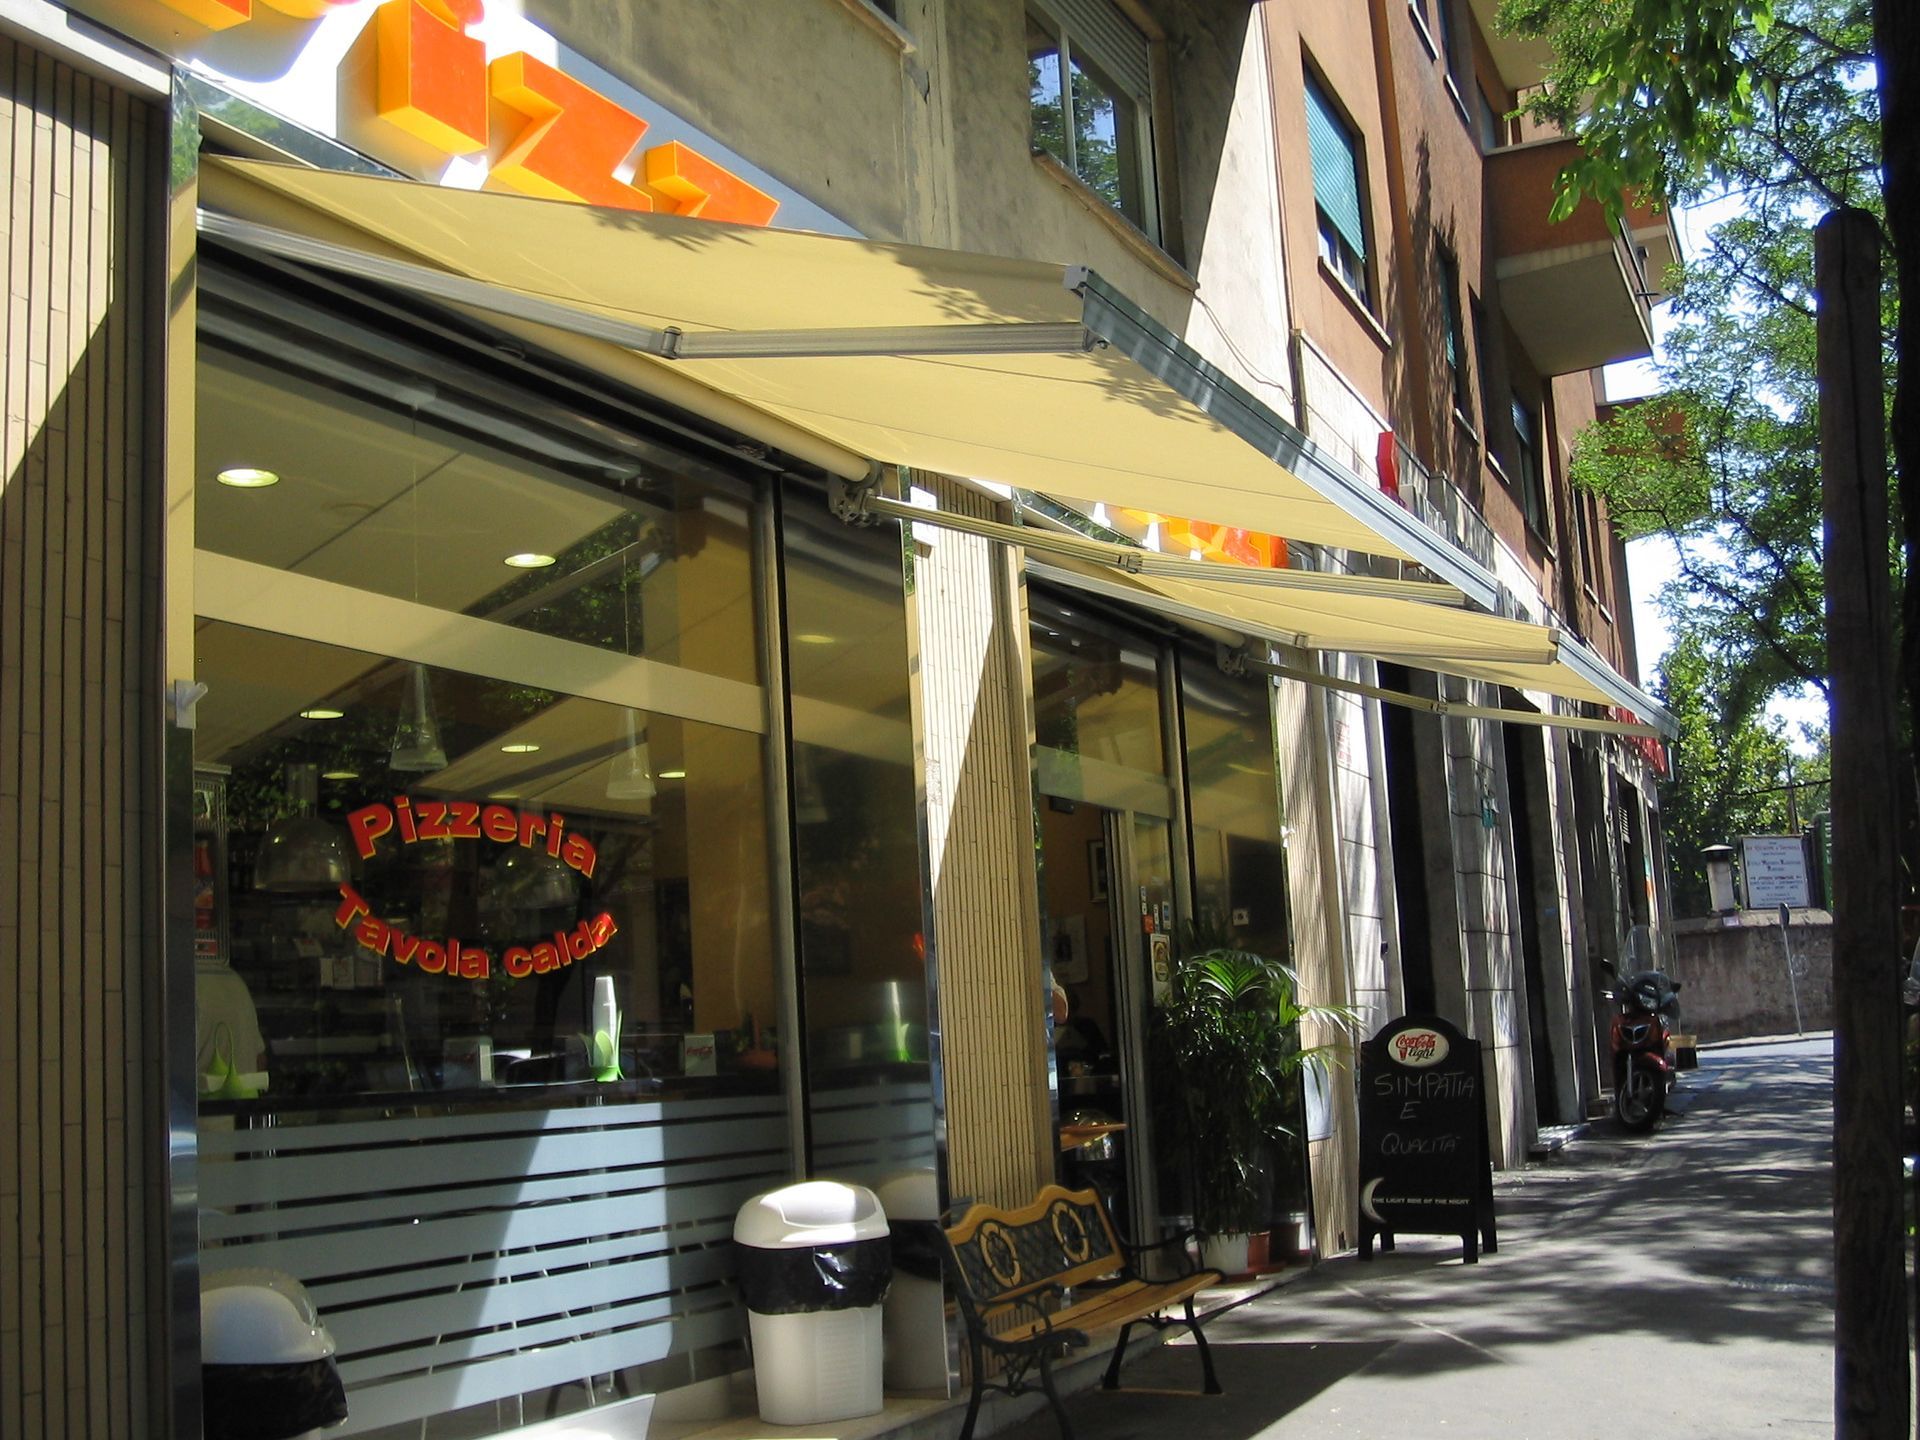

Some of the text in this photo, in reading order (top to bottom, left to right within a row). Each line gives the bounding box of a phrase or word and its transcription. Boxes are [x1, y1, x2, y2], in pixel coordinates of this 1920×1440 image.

[346, 794, 597, 879] Pizzeria
[334, 881, 619, 979] Tavola calda
[1374, 1071, 1474, 1098] SIMPATIA
[1399, 1101, 1422, 1119] E
